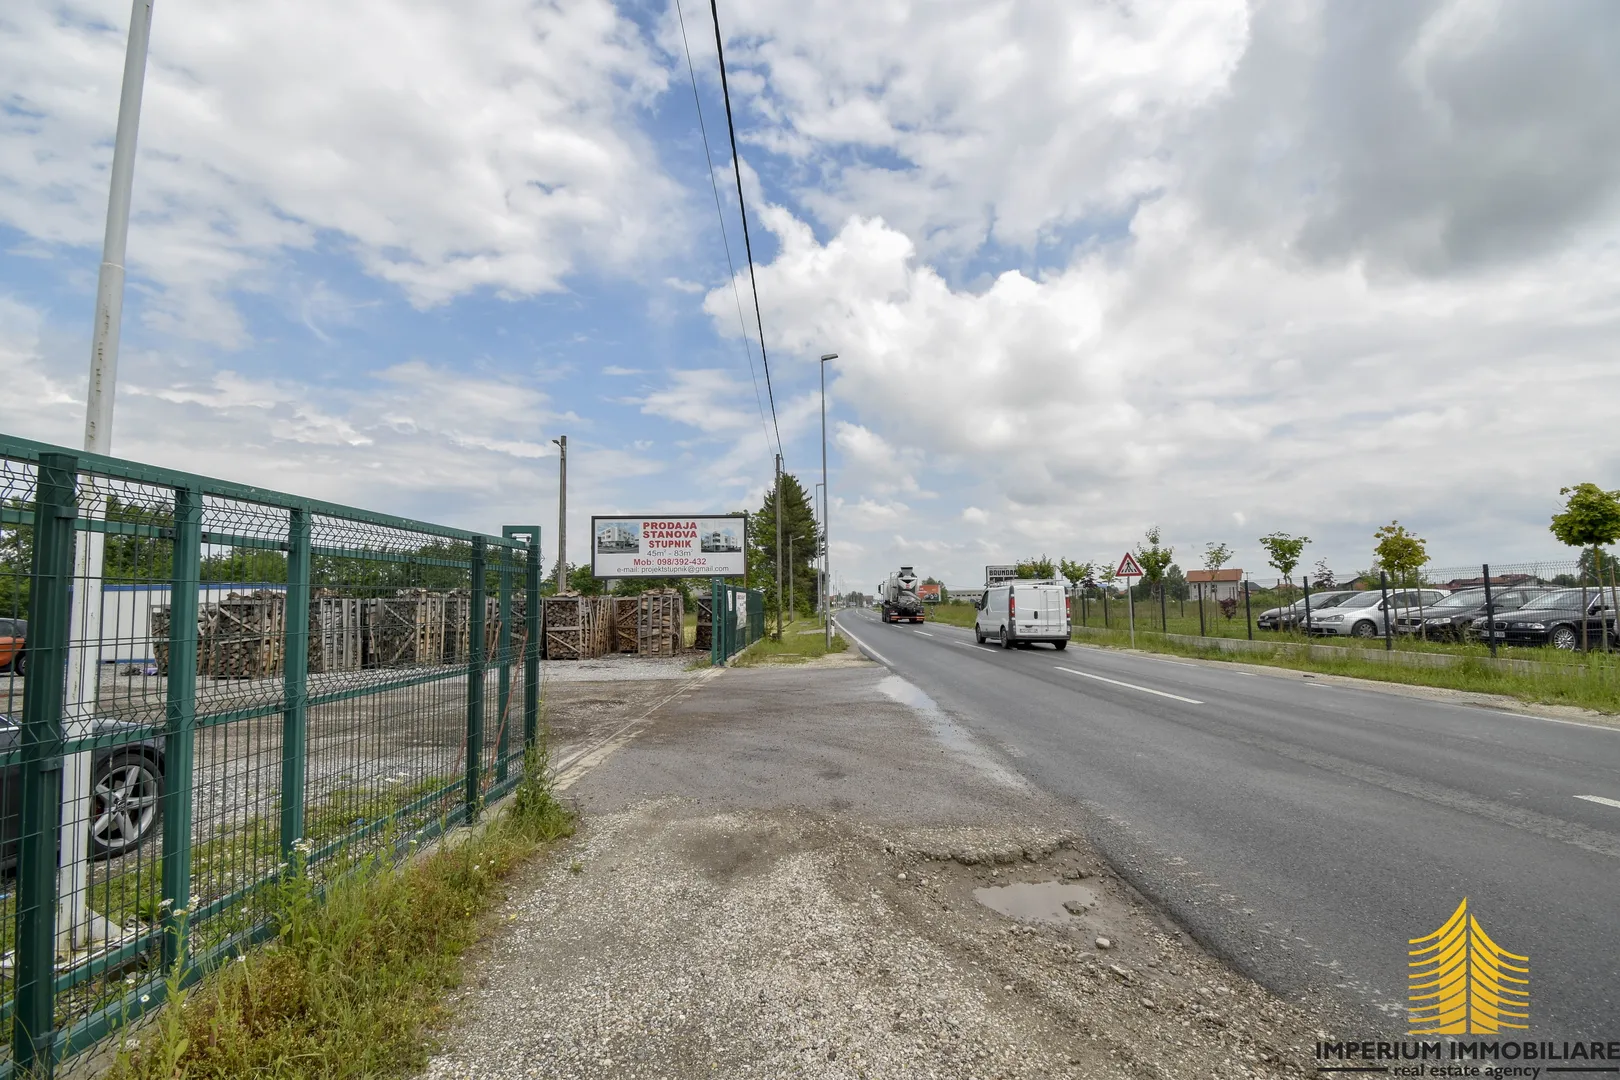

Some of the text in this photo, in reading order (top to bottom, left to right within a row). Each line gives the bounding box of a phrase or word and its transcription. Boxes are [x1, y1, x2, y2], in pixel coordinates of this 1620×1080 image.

[643, 522, 698, 530] PRODAJA
[643, 531, 697, 539] STANOVA
[648, 540, 692, 548] STUPNIK
[633, 558, 707, 566] Mob: 098/392-432
[641, 566, 729, 574] projektstupnik@gmail.com
